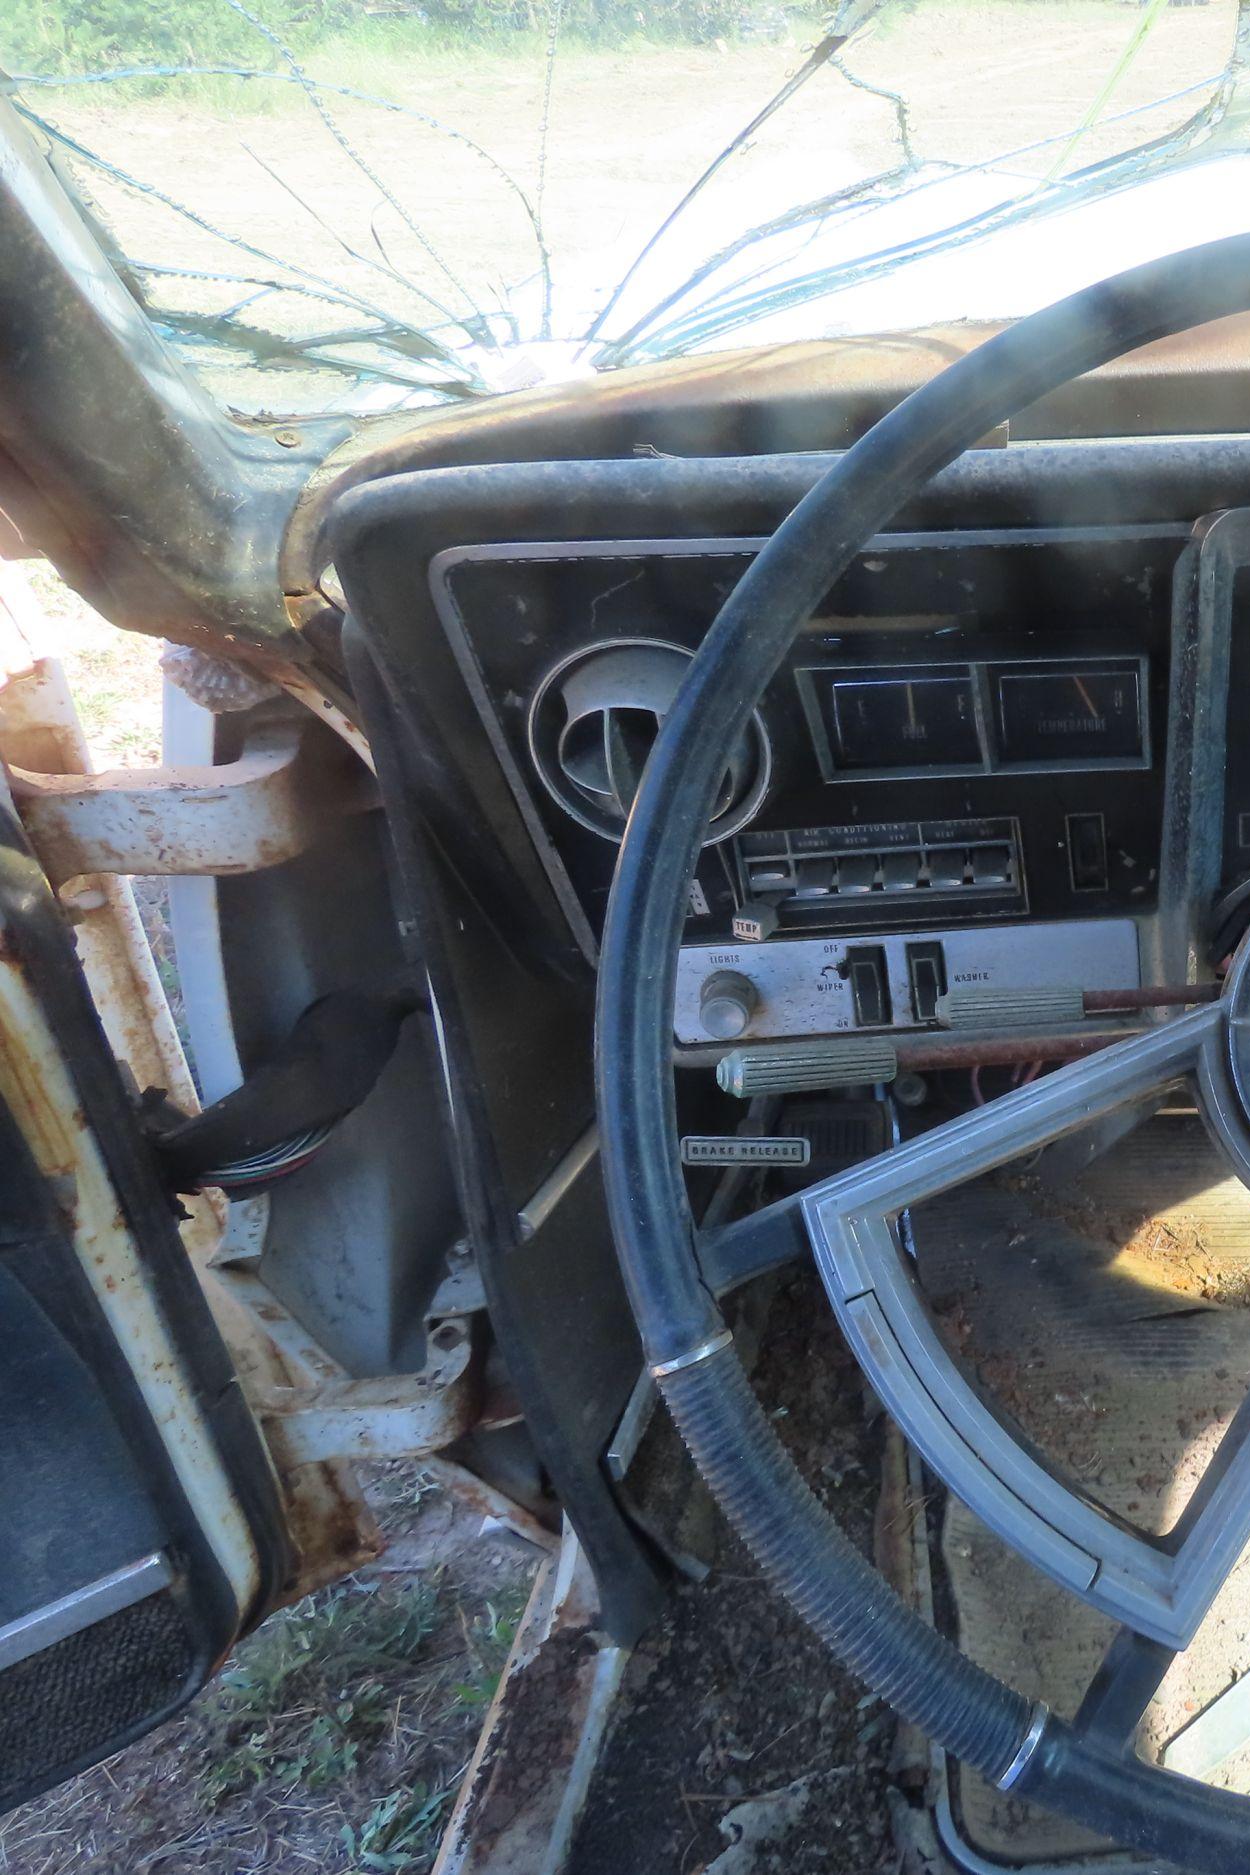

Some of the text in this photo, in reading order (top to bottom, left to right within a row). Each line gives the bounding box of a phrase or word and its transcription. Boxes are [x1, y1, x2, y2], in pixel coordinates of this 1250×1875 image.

[735, 920, 759, 934] TEMP
[822, 944, 840, 954] OFF
[709, 954, 741, 964] LIGHTS
[953, 972, 991, 984] WASHER
[815, 982, 845, 993] WIPER
[692, 1145, 799, 1157] BRAKE RELEASE
